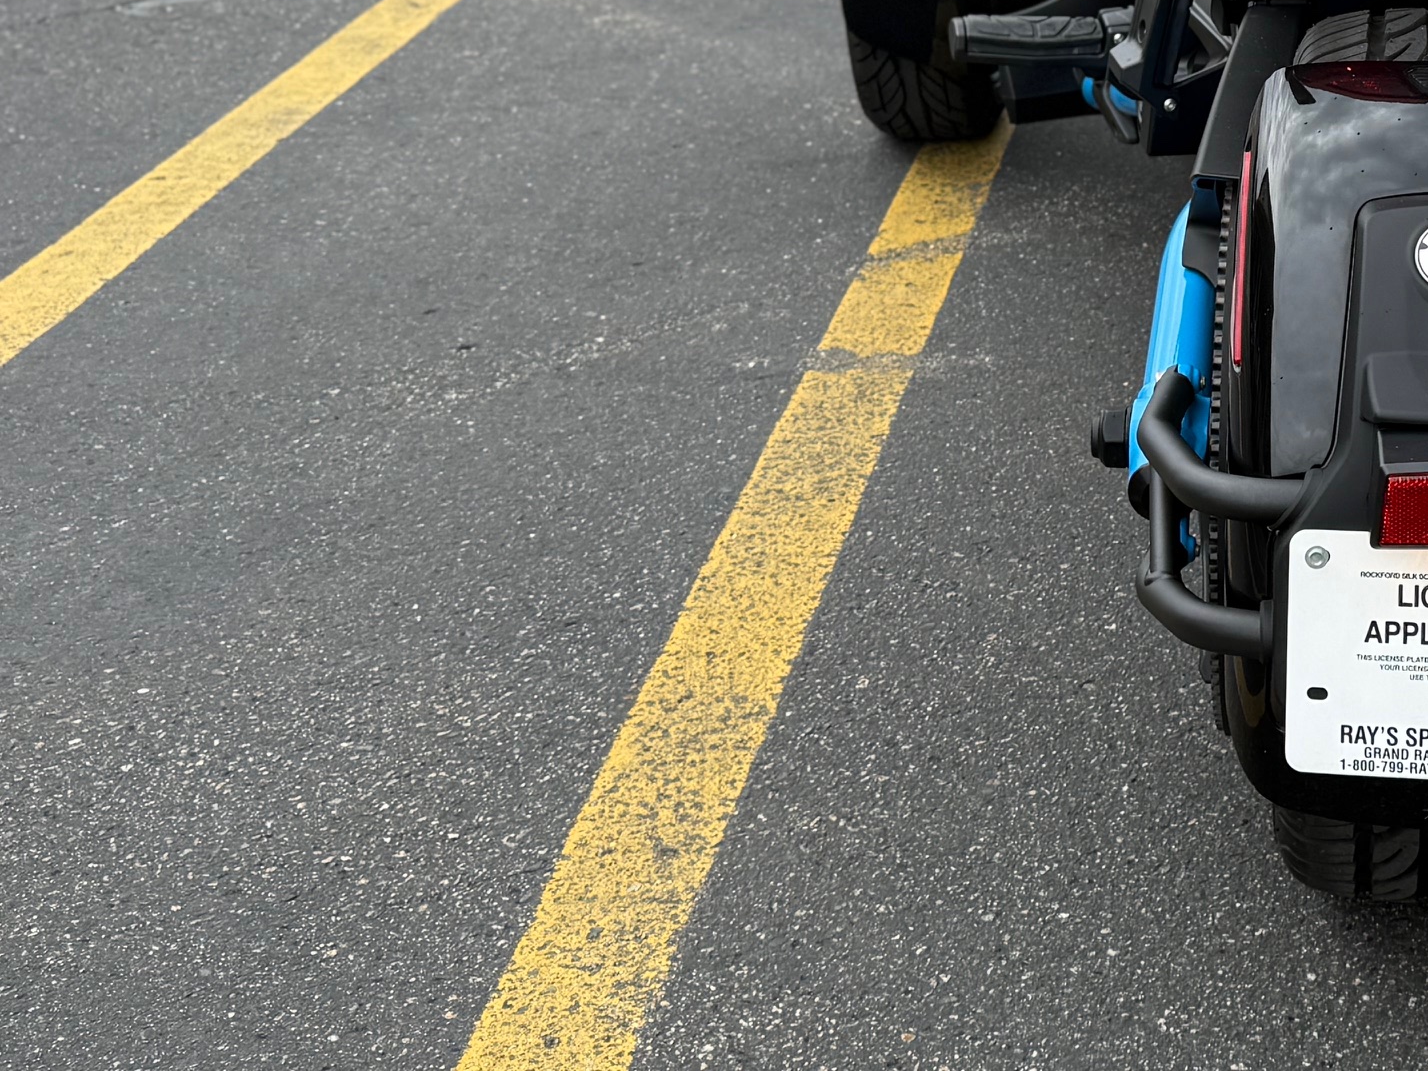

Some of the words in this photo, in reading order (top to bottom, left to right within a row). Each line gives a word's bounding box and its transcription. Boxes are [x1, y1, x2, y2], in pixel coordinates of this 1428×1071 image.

[1360, 571, 1400, 579] ROCKFORD
[1340, 724, 1398, 746] RAY'S
[1364, 746, 1409, 760] GRAND
